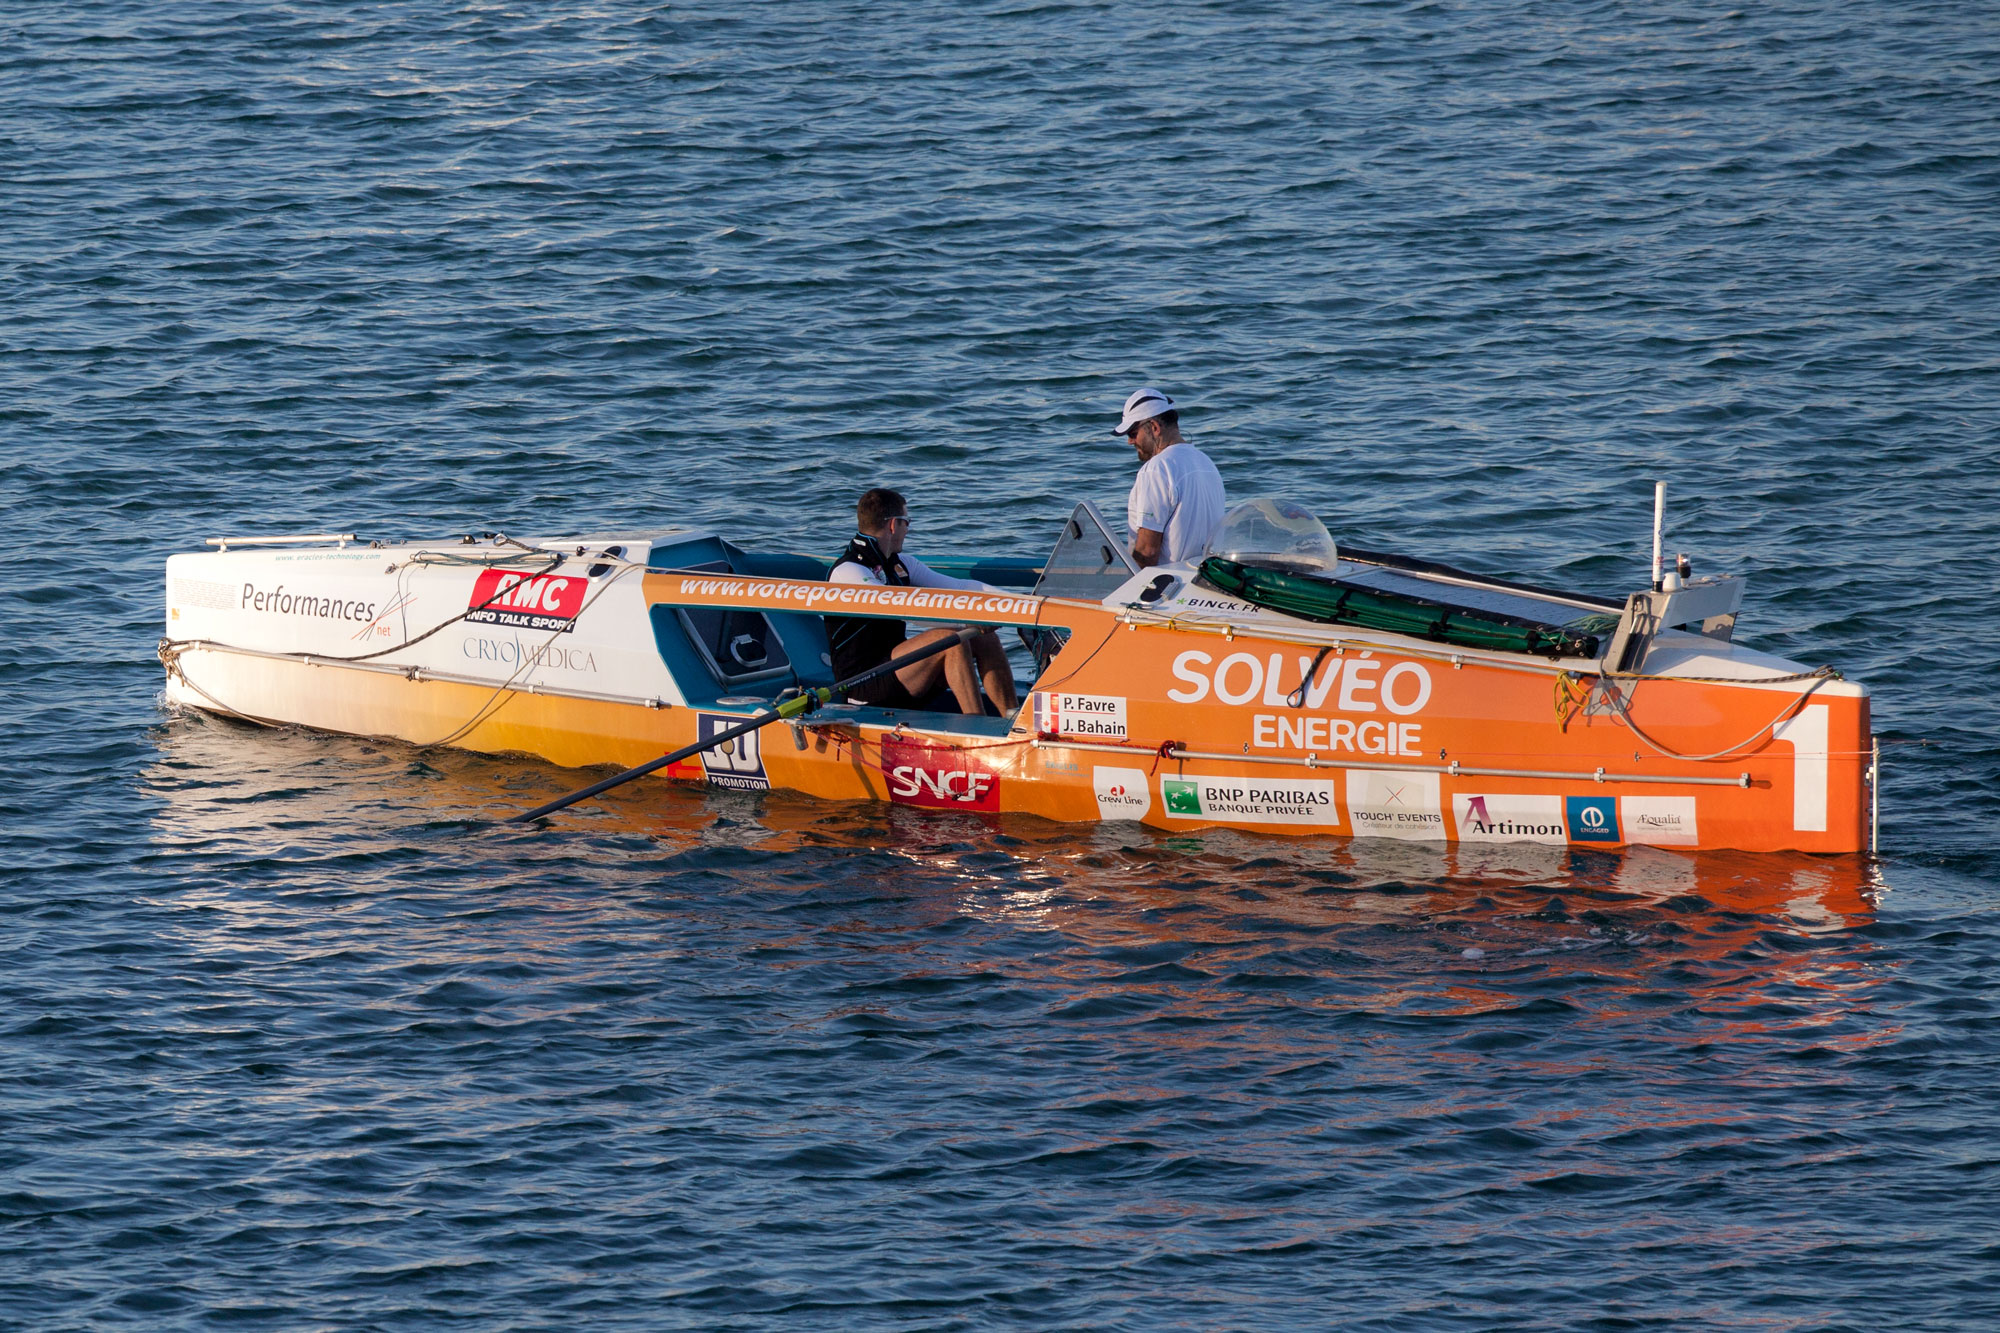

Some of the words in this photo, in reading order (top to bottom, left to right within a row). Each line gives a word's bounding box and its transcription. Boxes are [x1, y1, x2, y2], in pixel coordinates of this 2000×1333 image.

[491, 573, 569, 611] RMC
[680, 579, 1038, 615] www.votrepoemealamer.com
[242, 583, 375, 622] Performances
[1187, 598, 1261, 613] BINCK.FR
[466, 610, 497, 622] INFO
[499, 613, 530, 626] TALK
[531, 617, 575, 631] SPORT
[377, 626, 391, 637] net
[1167, 650, 1432, 715] SOLVÉO
[1063, 697, 1074, 710] P.
[1078, 697, 1116, 712] Favre
[1063, 719, 1074, 732] J.
[1077, 720, 1126, 735] Bahain
[1253, 714, 1423, 757] ENERGIE
[1773, 704, 1829, 832] 1
[711, 776, 768, 790] PROMOTION
[892, 766, 992, 802] SNCF
[1097, 794, 1122, 804] Crew
[1124, 796, 1144, 806] Line
[1205, 788, 1244, 802] BNP
[1250, 790, 1329, 805] PARIBAS
[1209, 803, 1263, 814] BANQUE
[1266, 804, 1315, 816] PRIVÉE
[1353, 811, 1395, 822] TOUCH'
[1397, 813, 1441, 823] EVENTS
[1394, 822, 1404, 830] de
[1472, 819, 1563, 836] Artimon
